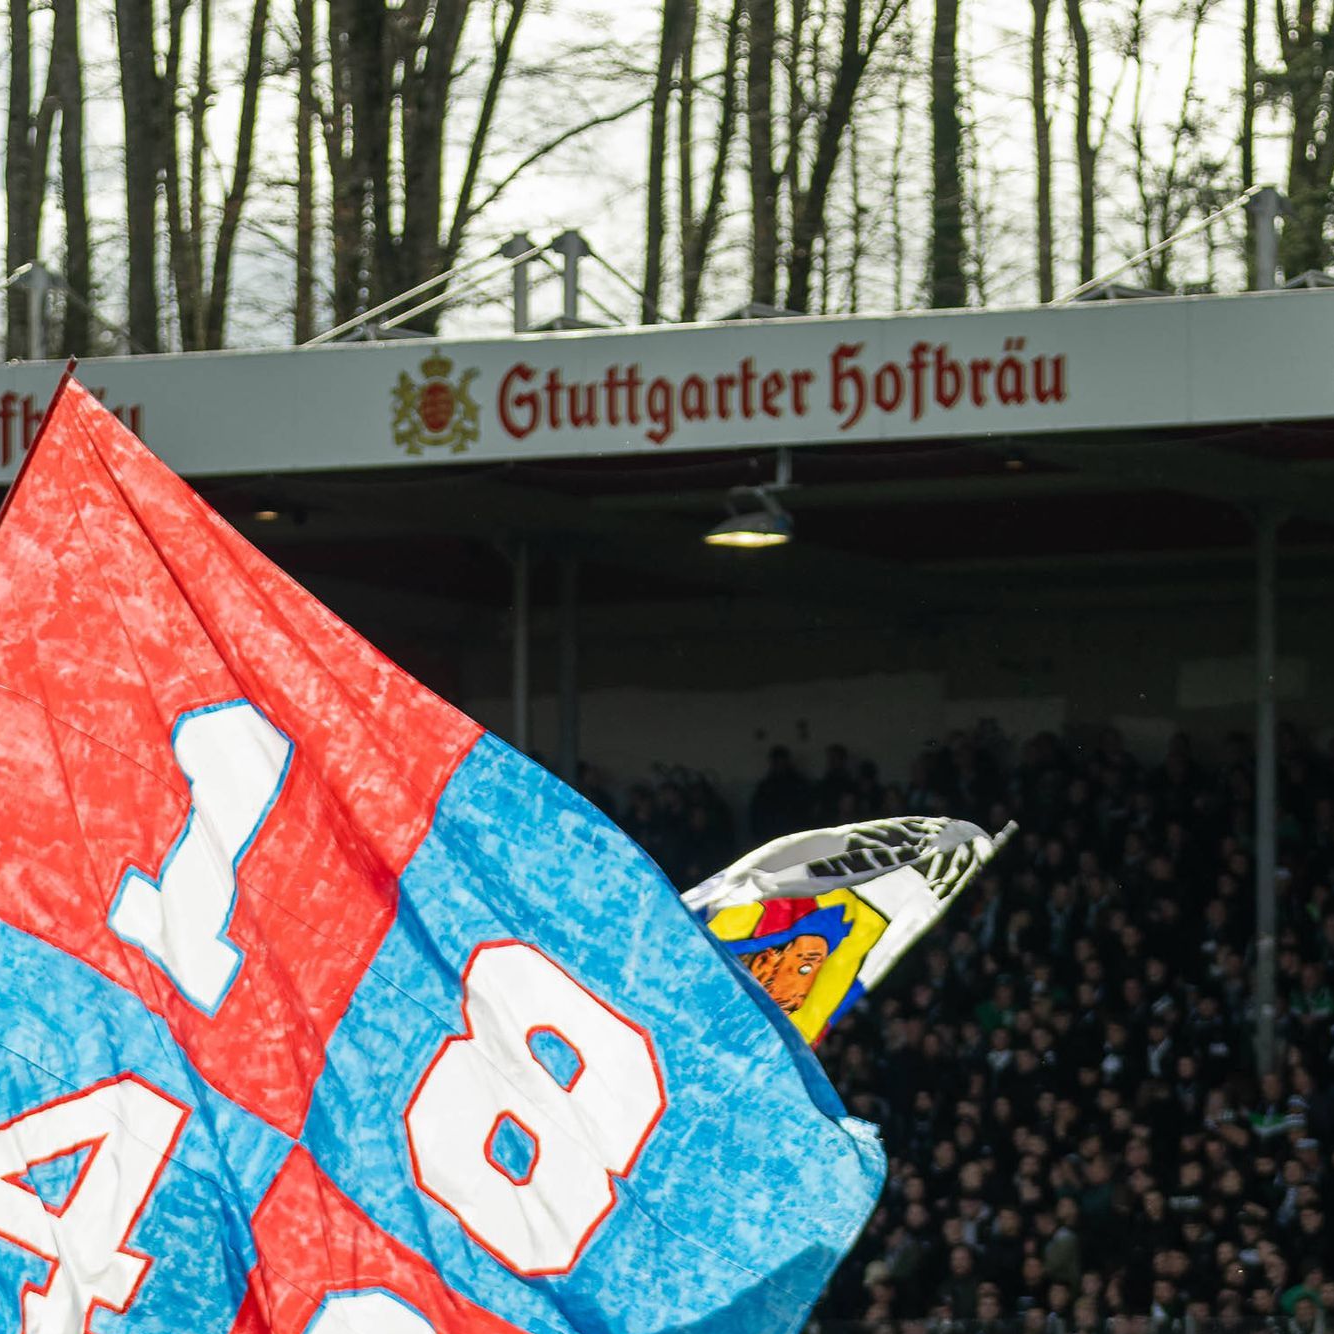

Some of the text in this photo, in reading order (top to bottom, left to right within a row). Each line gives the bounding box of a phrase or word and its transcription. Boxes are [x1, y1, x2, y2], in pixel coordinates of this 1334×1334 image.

[496, 336, 1068, 446] Stuttgarter Hofbräu
[404, 940, 665, 1275] 8
